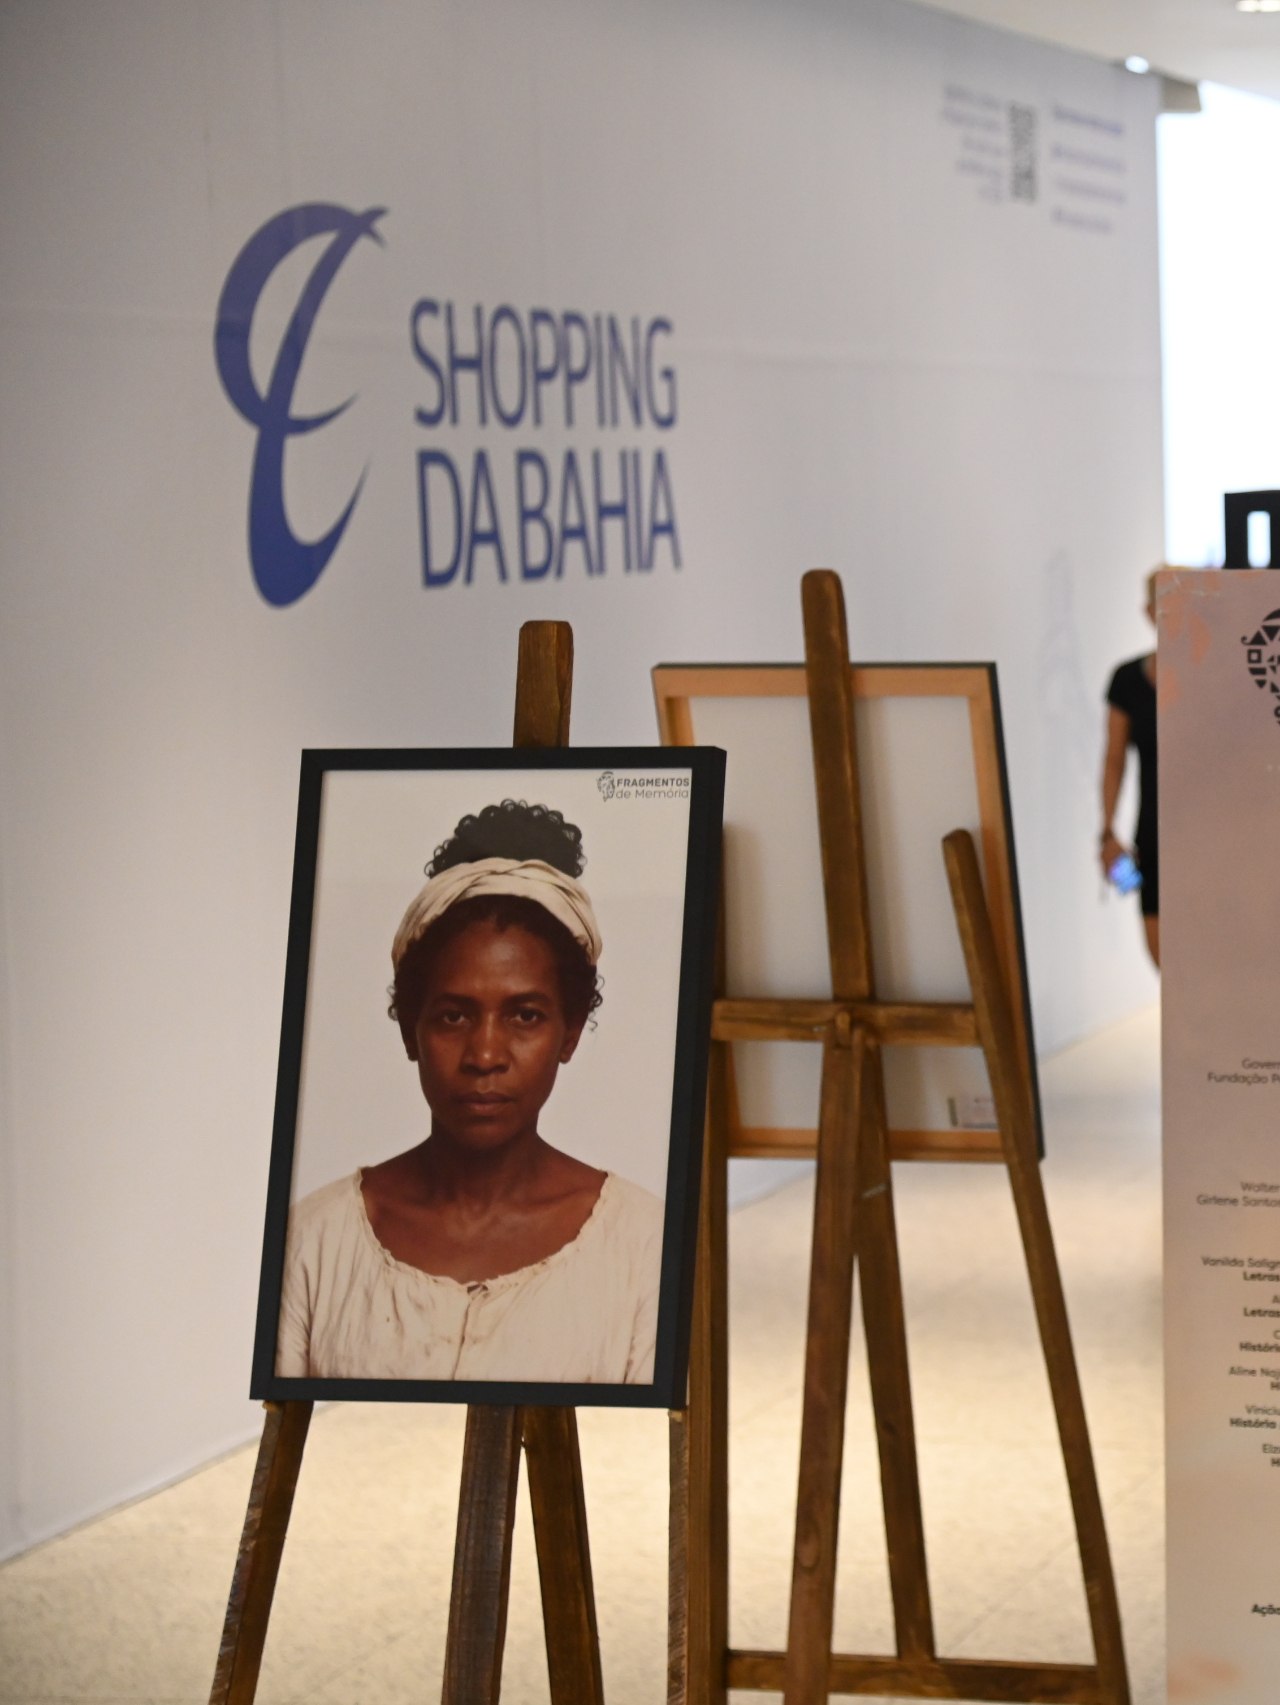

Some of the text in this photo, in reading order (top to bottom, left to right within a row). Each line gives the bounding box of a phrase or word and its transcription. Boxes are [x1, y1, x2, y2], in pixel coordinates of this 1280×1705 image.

[411, 298, 677, 430] SHOPPING
[418, 449, 681, 589] DA BAHIA
[617, 778, 689, 787] FRAGMENTOS
[616, 789, 688, 799] de Memória
[1207, 1072, 1268, 1086] Fundação
[1243, 1272, 1280, 1282] Letras
[1244, 1308, 1280, 1318] Letras
[1229, 1366, 1257, 1376] Aline
[1230, 1418, 1277, 1429] História
